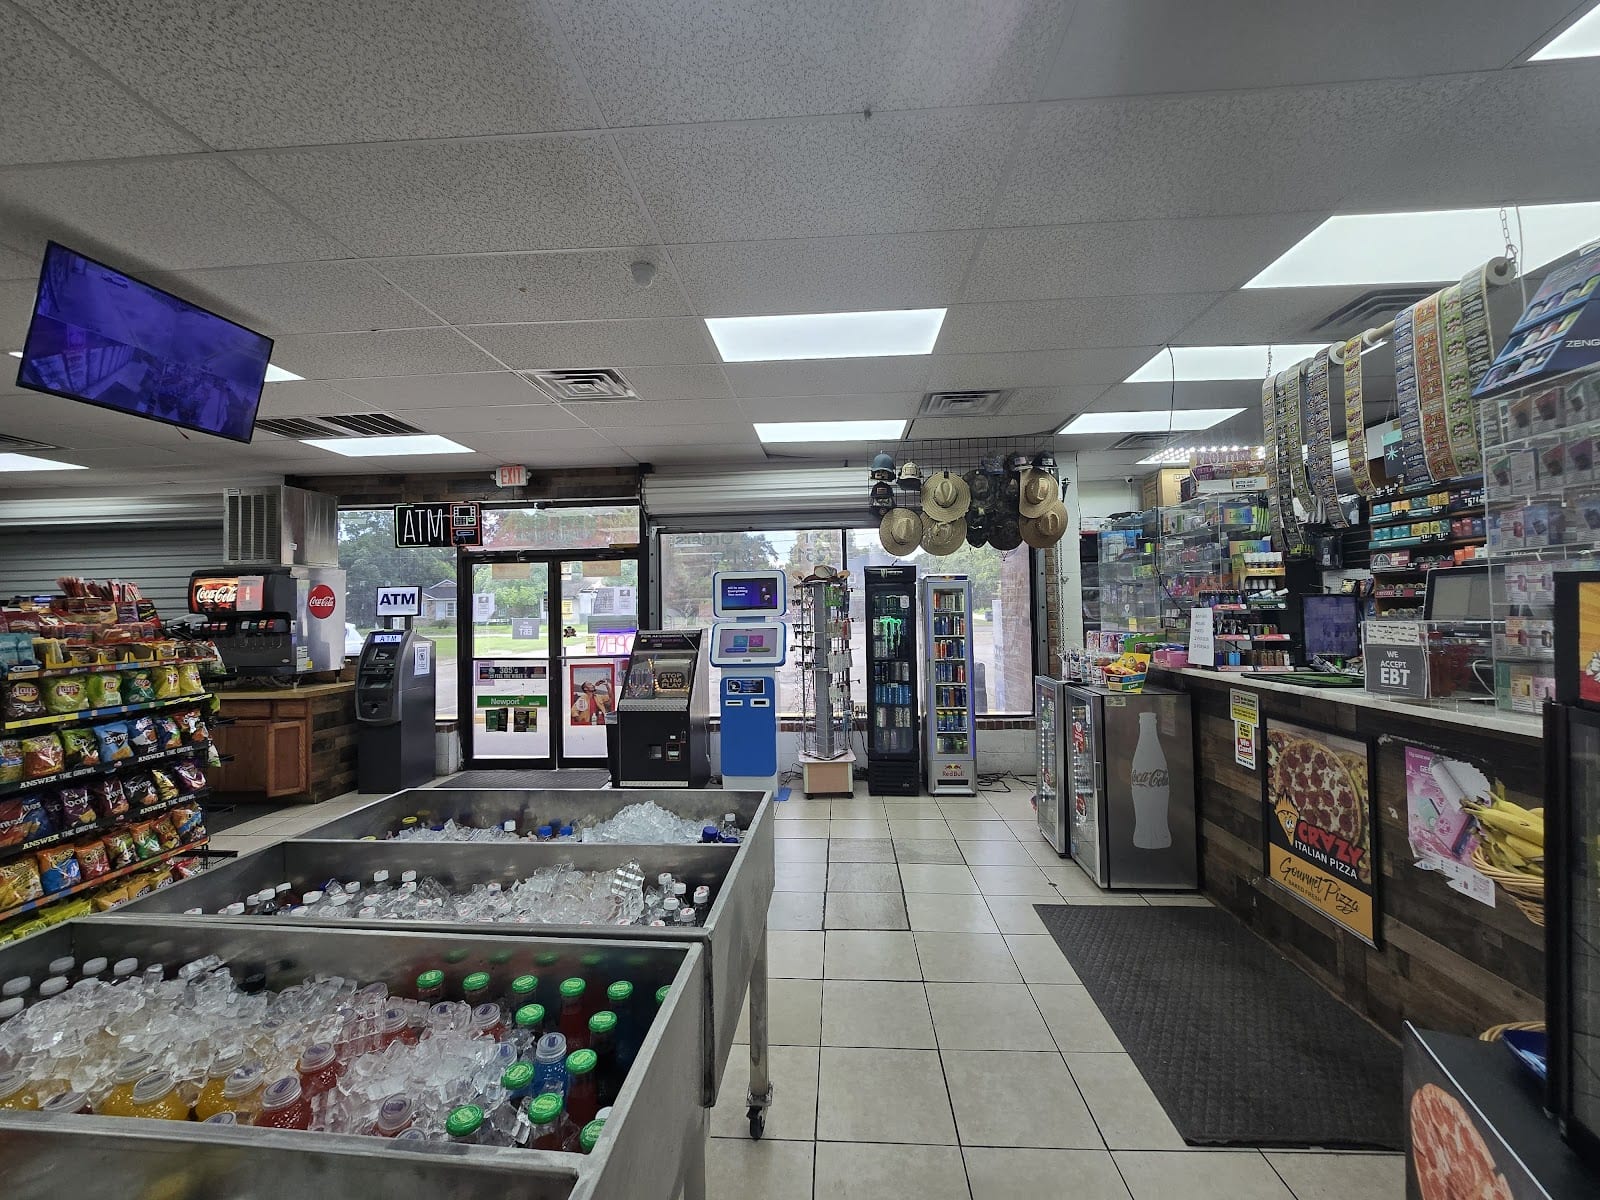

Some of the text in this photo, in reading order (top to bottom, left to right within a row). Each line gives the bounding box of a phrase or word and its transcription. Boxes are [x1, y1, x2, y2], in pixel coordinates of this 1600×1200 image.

[500, 466, 522, 484] EXIT
[403, 508, 444, 542] ATM
[197, 586, 238, 604] Coca-Cola
[309, 594, 335, 608] Coca-Cola
[379, 593, 416, 606] ATM
[379, 635, 397, 643] ATM
[1386, 650, 1400, 658] WE
[1380, 660, 1407, 668] ACCEPT
[1380, 667, 1411, 686] EBT
[490, 697, 520, 707] Newport
[138, 752, 165, 763] ANSWER
[20, 775, 57, 789] ANSWER
[73, 767, 97, 777] GROWL
[140, 802, 167, 815] ANSWER
[23, 822, 98, 850] ANSWER THE GROWL
[1297, 820, 1366, 868] CRAZY
[1294, 840, 1358, 880] ITALIAN PIZZA
[1280, 857, 1359, 914] Gourmet Pizza
